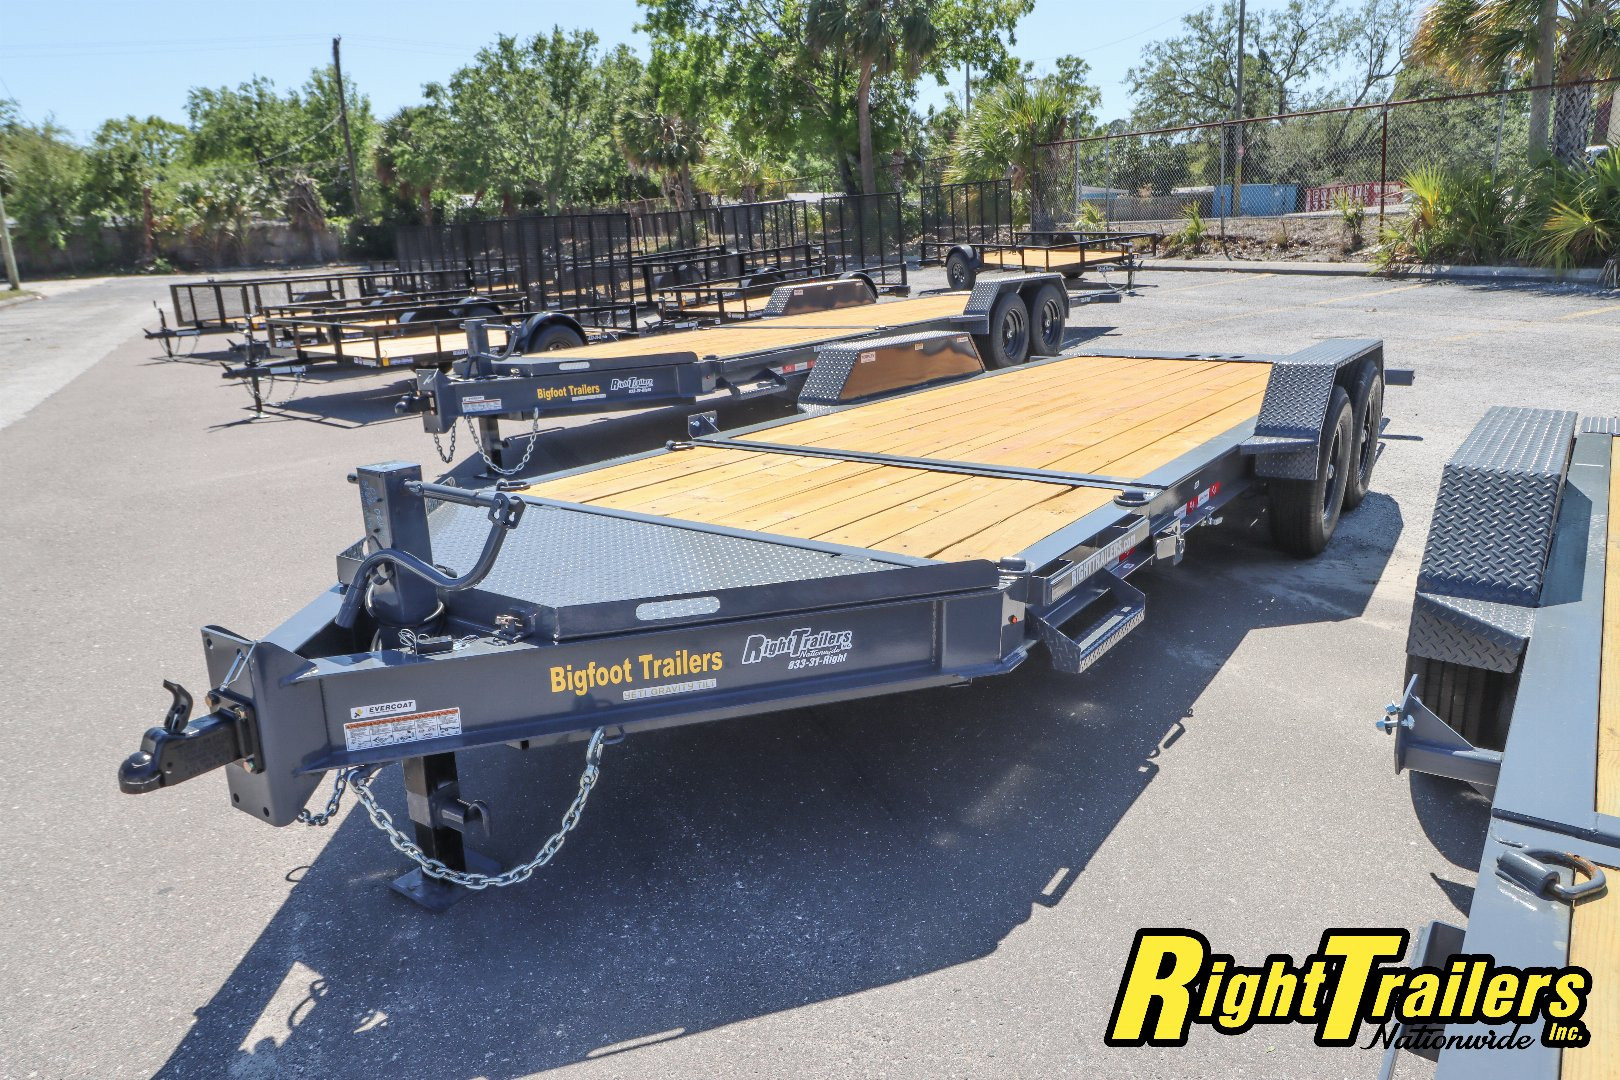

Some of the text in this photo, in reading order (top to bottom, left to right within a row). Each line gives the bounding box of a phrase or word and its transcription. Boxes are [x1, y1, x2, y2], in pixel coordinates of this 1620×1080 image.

[537, 386, 567, 400] Bigfoot
[568, 383, 600, 396] Trailers
[787, 652, 848, 670] 833-31-Right
[549, 649, 724, 697] Bigfoot Trailers
[623, 679, 716, 700] YETI GRAVITY TILT
[369, 701, 414, 713] EVERCOAT
